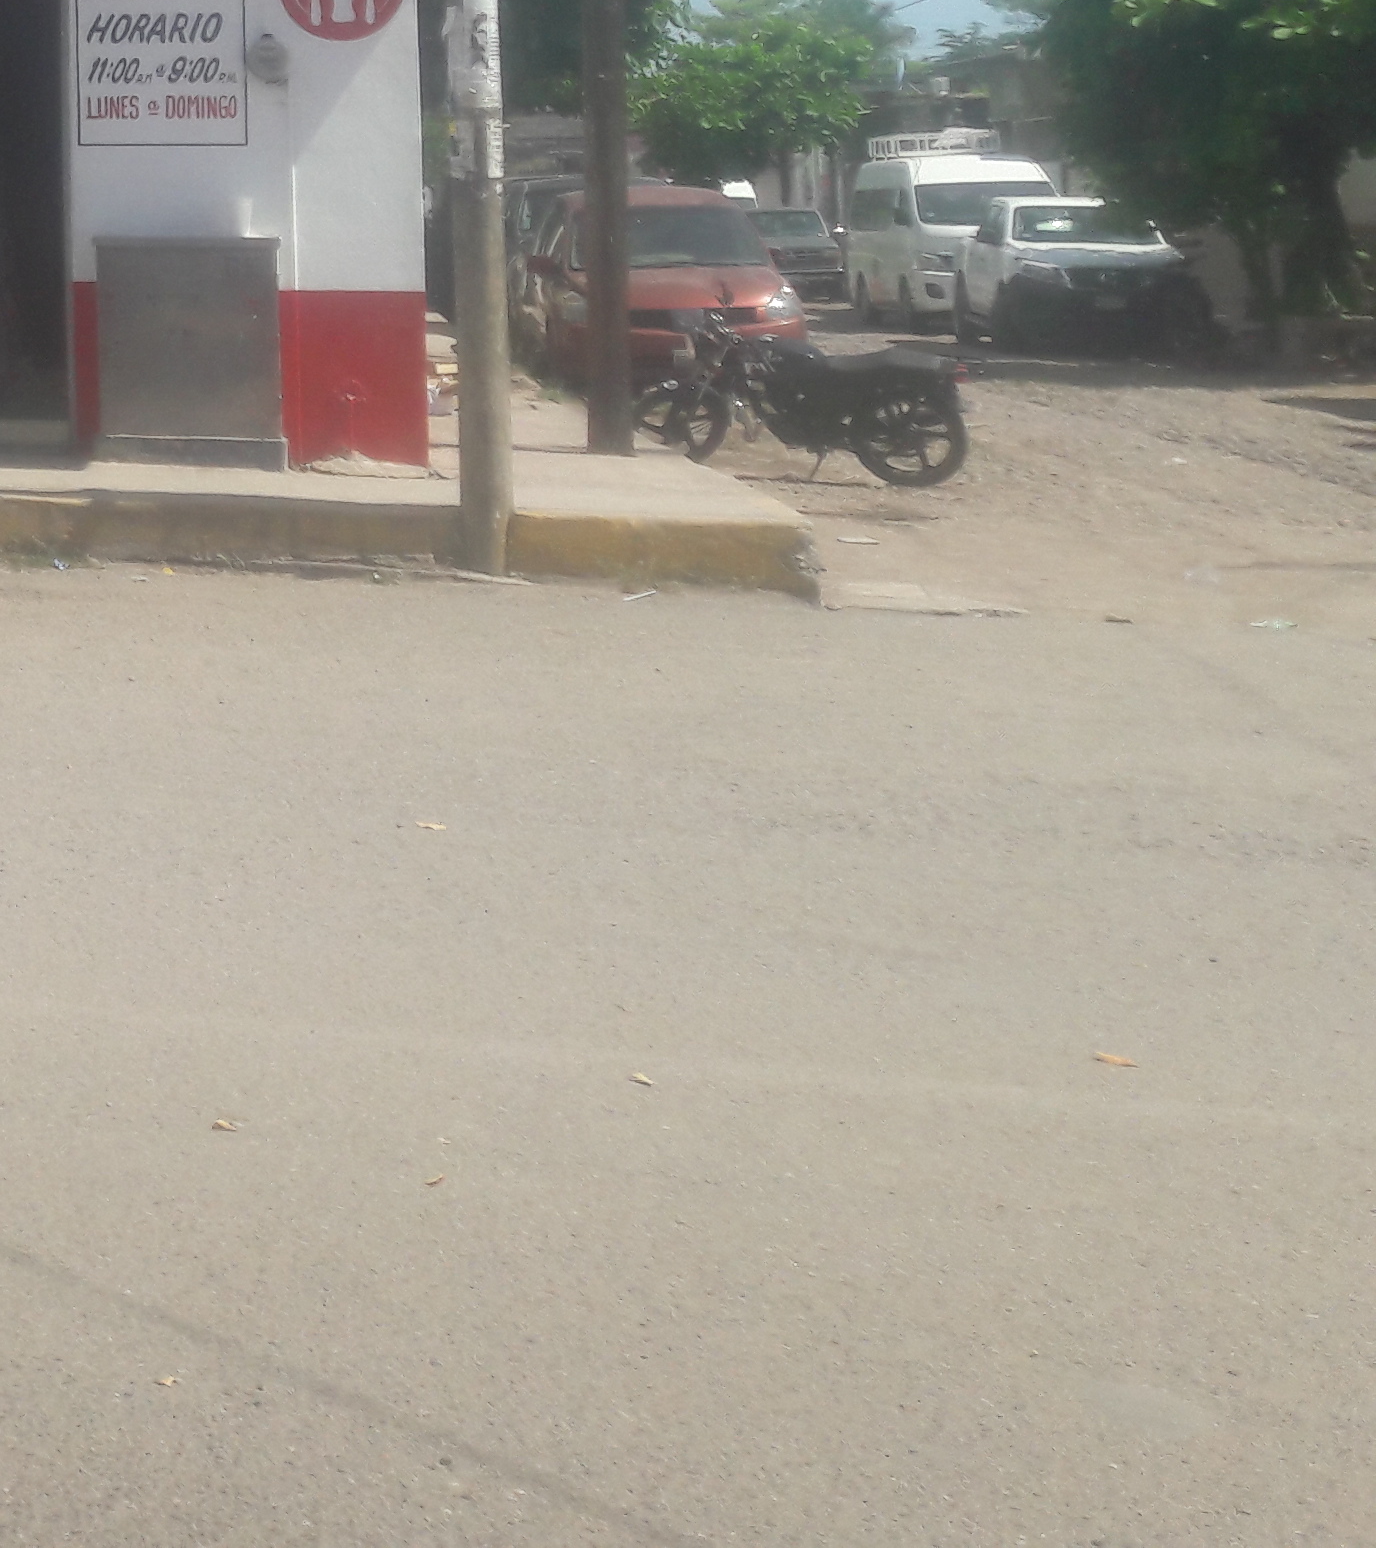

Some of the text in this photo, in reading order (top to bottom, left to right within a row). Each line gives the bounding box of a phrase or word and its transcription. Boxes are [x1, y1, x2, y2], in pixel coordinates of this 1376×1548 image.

[86, 12, 224, 44] HORARIO
[86, 95, 140, 120] LUNES
[165, 94, 238, 120] DOMINGO
